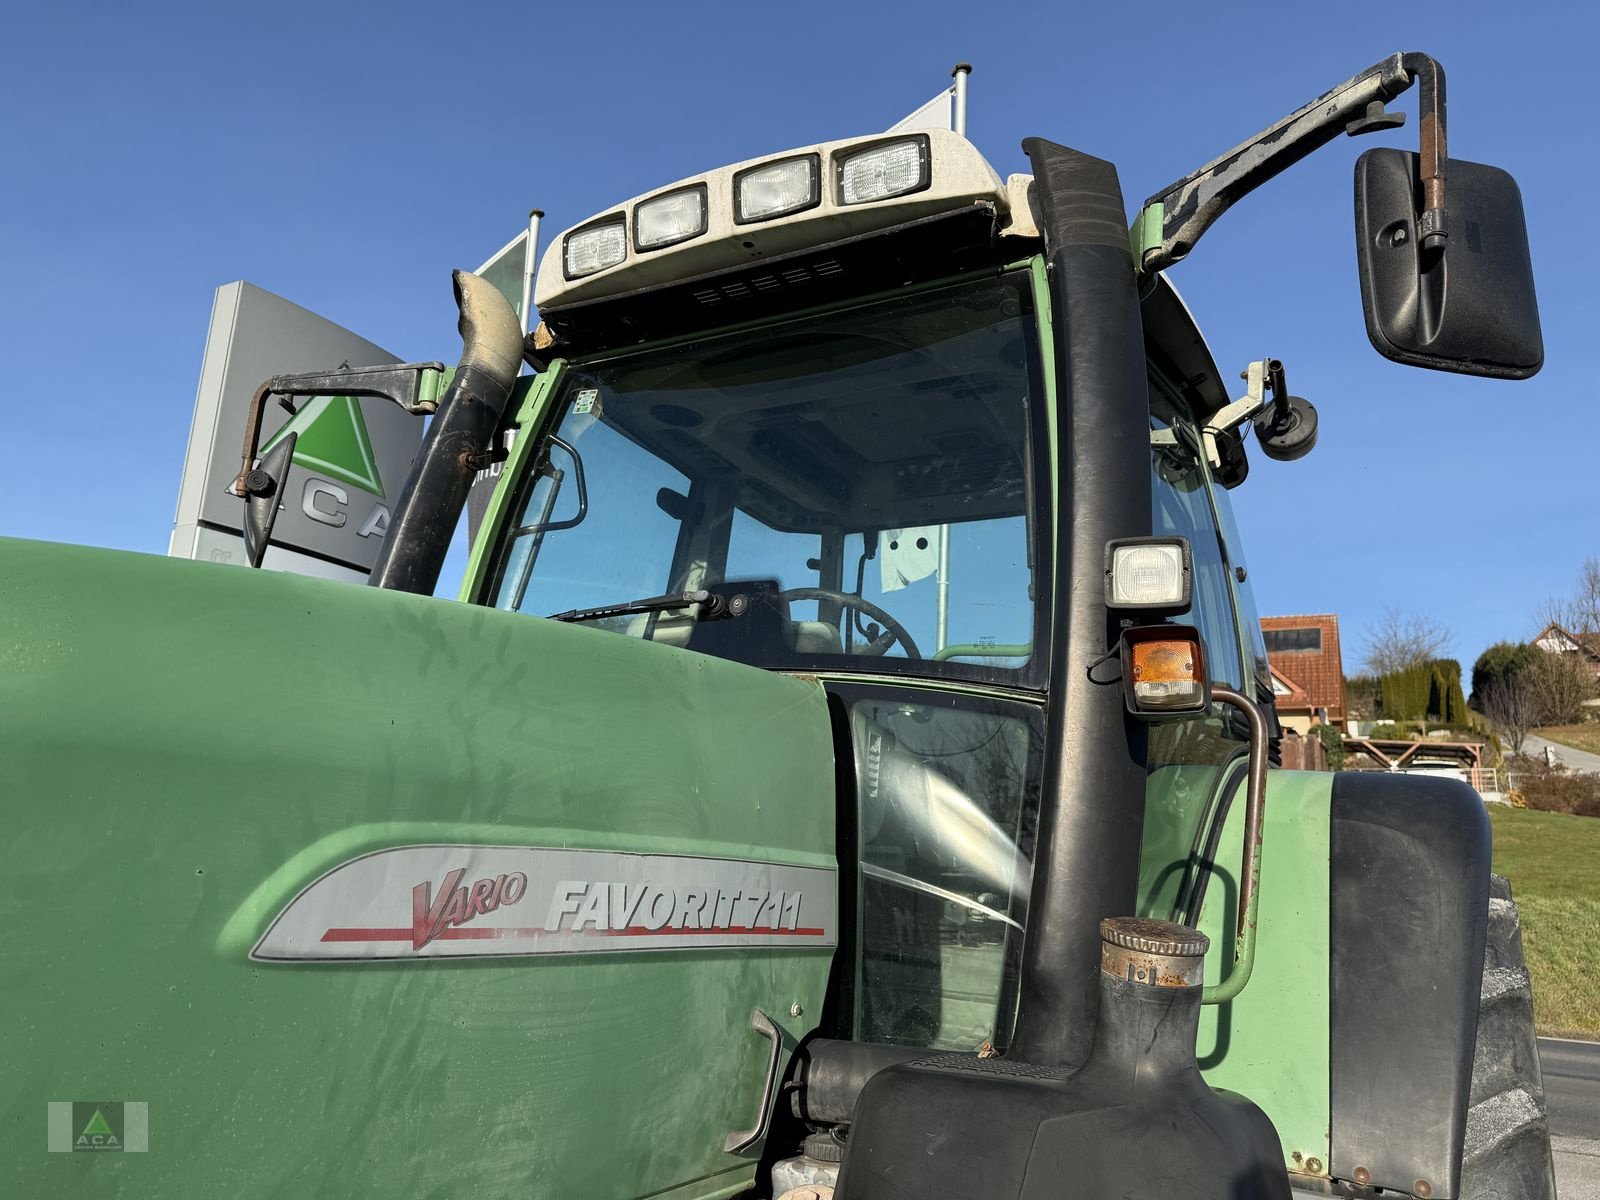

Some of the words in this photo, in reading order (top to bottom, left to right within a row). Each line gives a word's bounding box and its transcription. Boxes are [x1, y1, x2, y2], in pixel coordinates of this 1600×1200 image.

[224, 458, 392, 538] CA
[543, 880, 742, 934] FAVORIT
[743, 888, 802, 932] 711
